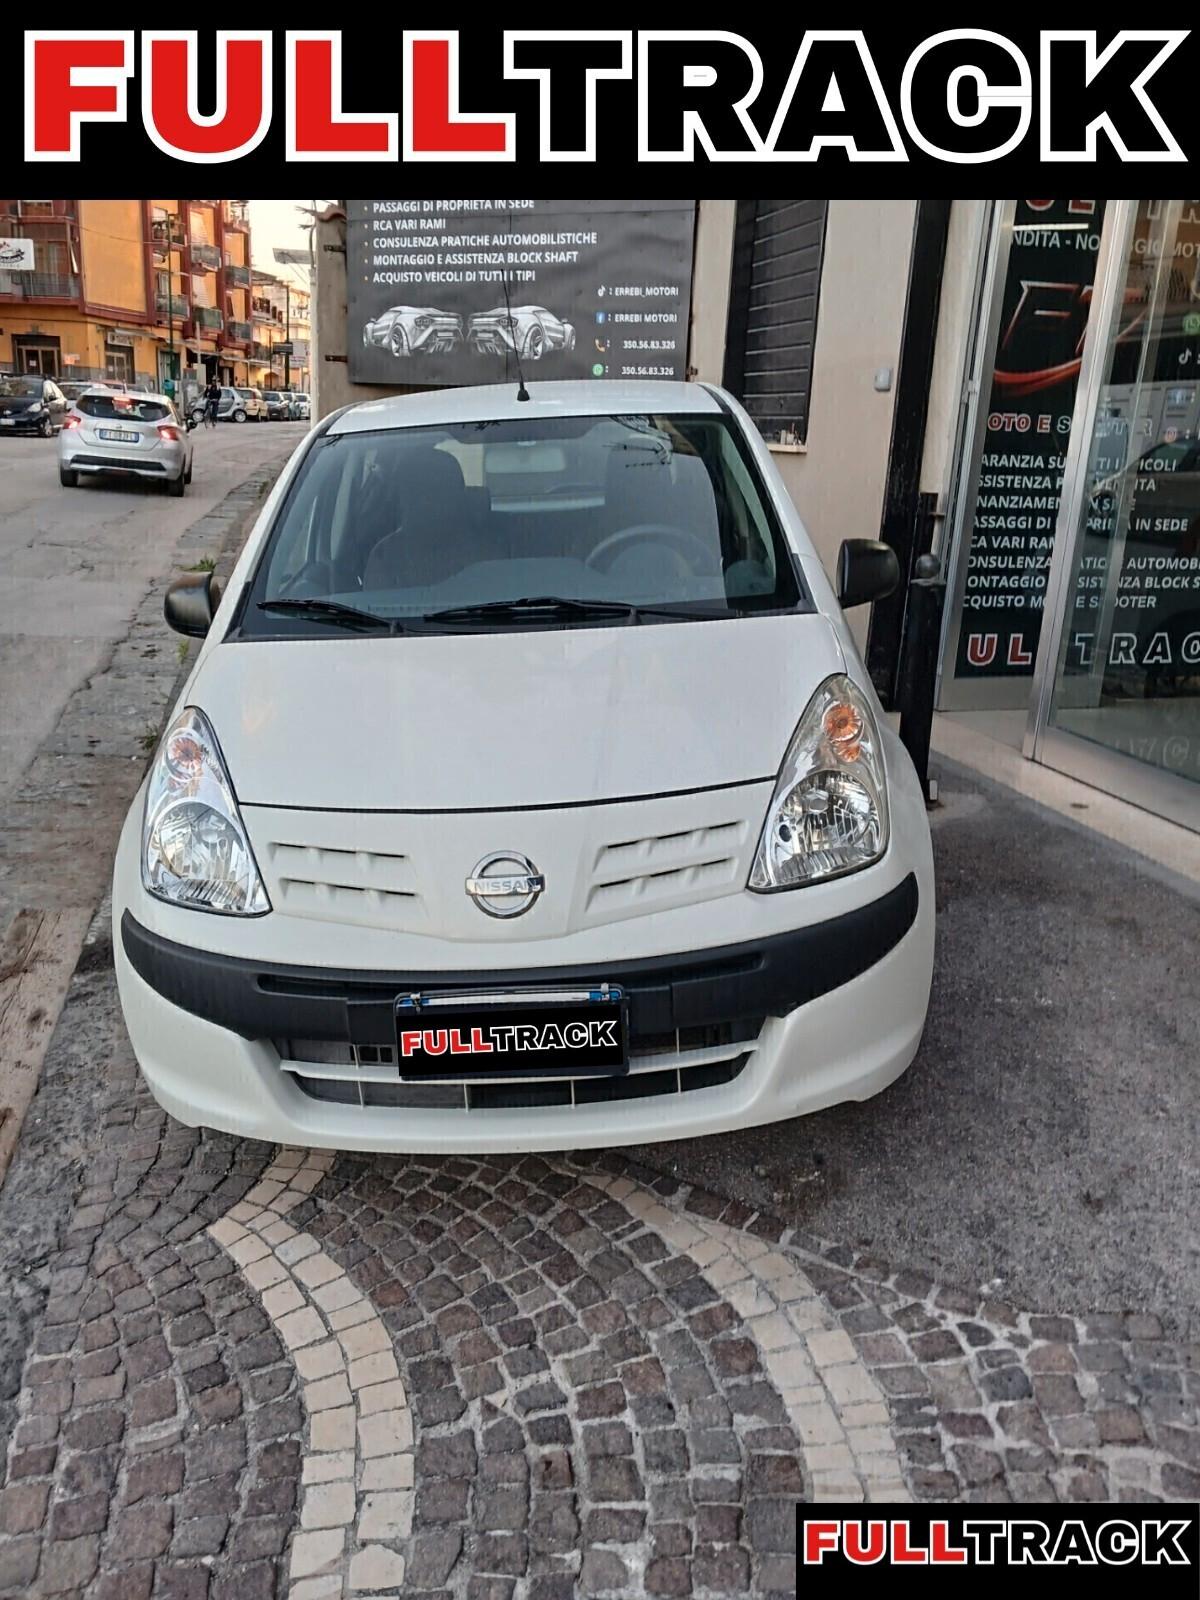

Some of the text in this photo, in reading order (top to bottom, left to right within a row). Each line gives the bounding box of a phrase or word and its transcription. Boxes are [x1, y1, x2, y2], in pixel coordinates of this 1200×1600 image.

[373, 201, 420, 213] PASSAGGI
[423, 201, 433, 211] DI
[495, 200, 506, 209] IN
[509, 200, 534, 208] SEDE
[373, 218, 446, 231] RCA VARI RAMI
[373, 232, 597, 248] CONSULENZA PRATICHE AUTOMOBILISTICHE
[1012, 230, 1060, 248] NDITA
[373, 251, 579, 265] MONTAGGIO E ASSISTENZA BLOCK SHAFT
[373, 271, 422, 284] ACQUISTO
[424, 271, 462, 282] VEICOLI
[465, 271, 476, 281] DI
[478, 271, 507, 281] TUTTI
[516, 270, 536, 281] TIPI
[614, 313, 642, 322] ERREBI
[644, 313, 677, 322] MOTORI
[988, 412, 1031, 432] OTO
[1037, 414, 1051, 433] E
[981, 454, 1044, 468] ARANZIA
[1140, 459, 1177, 472] ICOLI
[978, 475, 1051, 489] SSISTENZA
[976, 495, 1061, 509] NANZIAME
[974, 516, 1032, 529] SSAGGI
[1036, 516, 1051, 529] DI
[1135, 518, 1151, 530] IN
[1154, 518, 1189, 531] SEDE
[971, 535, 987, 548] CA
[991, 535, 1025, 548] VARI
[967, 555, 1053, 568] ONSULENZA
[967, 575, 1046, 588] ONTAGGIO
[1145, 576, 1191, 588] BLOCK
[963, 595, 1025, 610] CQUISTO
[474, 880, 537, 893] NISSAN
